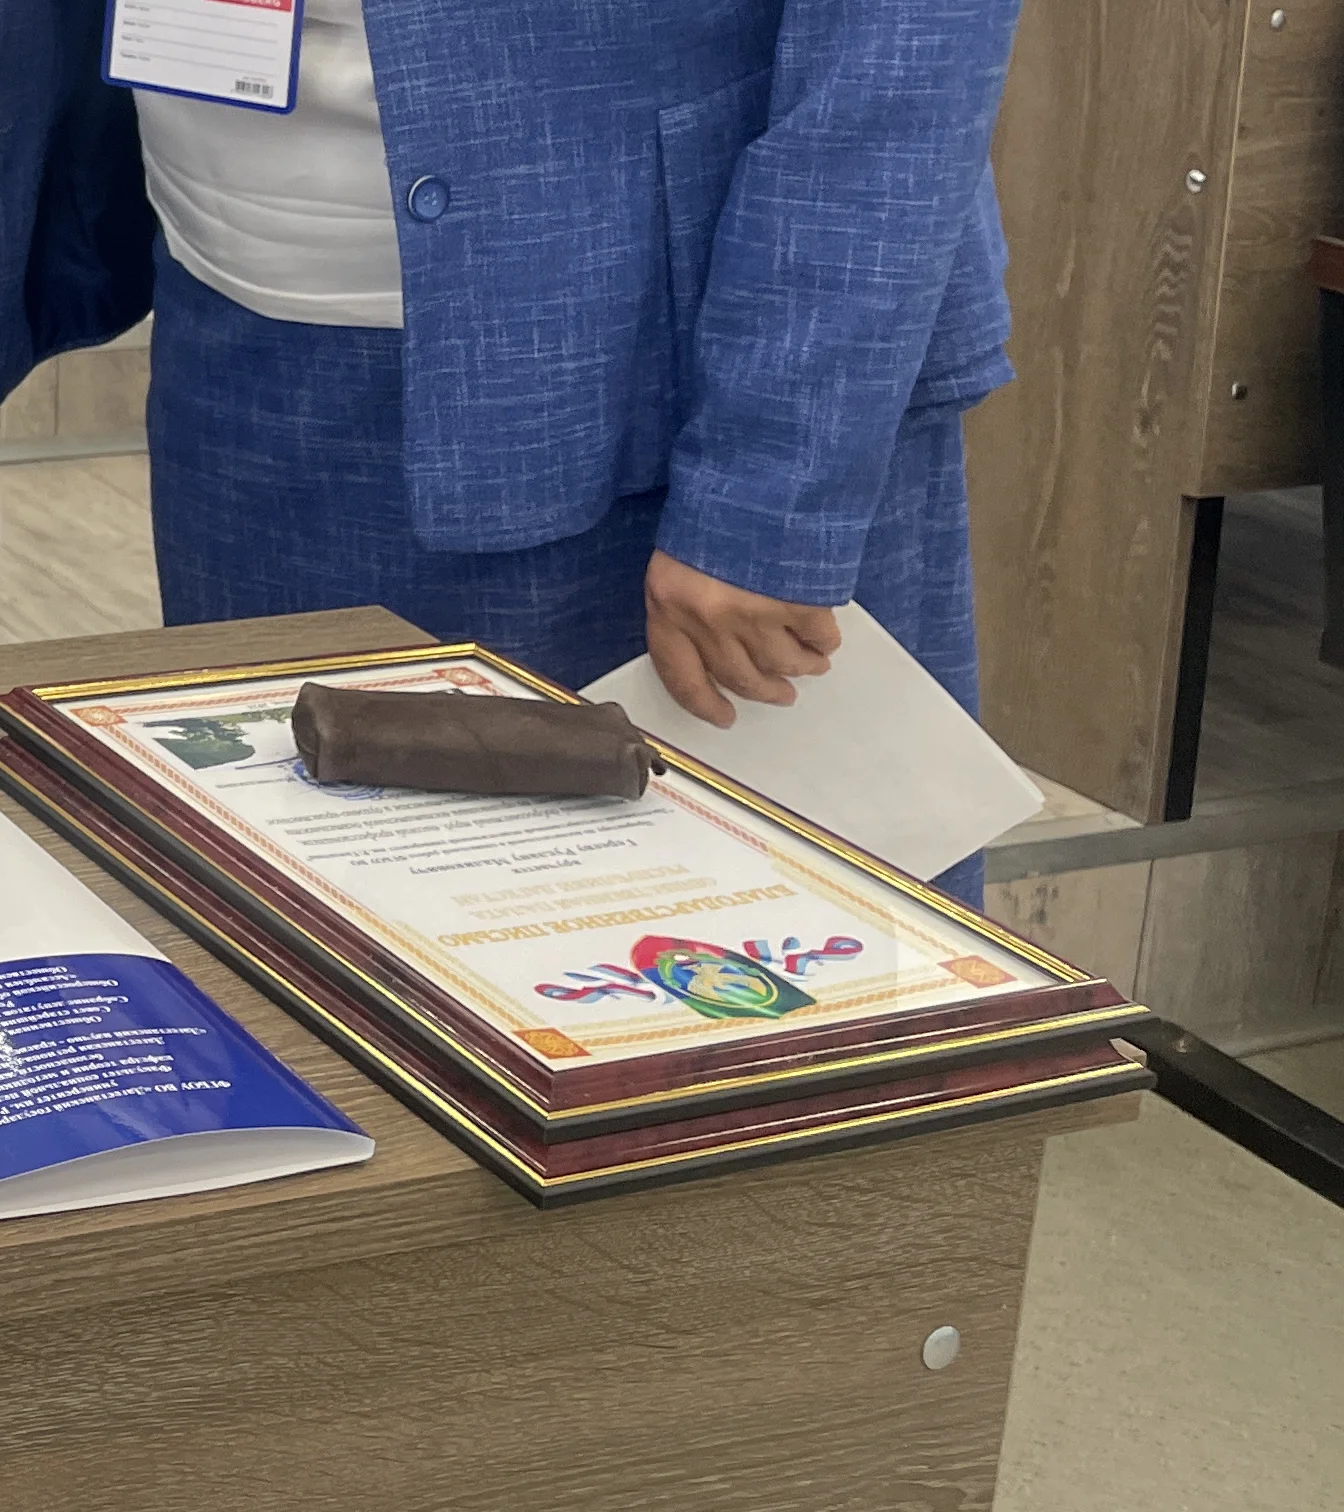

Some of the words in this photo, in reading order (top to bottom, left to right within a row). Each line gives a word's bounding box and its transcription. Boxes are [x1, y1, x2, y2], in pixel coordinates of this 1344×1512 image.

[543, 883, 798, 936] БЛАГОДАРСТВЕННОЕ
[437, 921, 550, 949] ПИСЬМО
[68, 995, 129, 1007] Собрание
[0, 1009, 71, 1029] старейшин
[73, 1006, 111, 1016] Совет
[67, 1032, 113, 1045] научно
[114, 1028, 207, 1039] «Дагестанский
[79, 1036, 165, 1054] Дагестанская
[72, 1059, 117, 1076] теории
[102, 1065, 173, 1080] Факультет
[21, 1073, 100, 1099] социальной
[37, 1080, 119, 1105] университет
[182, 1081, 231, 1090] ФГБОУ
[10, 1099, 33, 1113] им.
[53, 1086, 152, 1114] «Дагестанский
